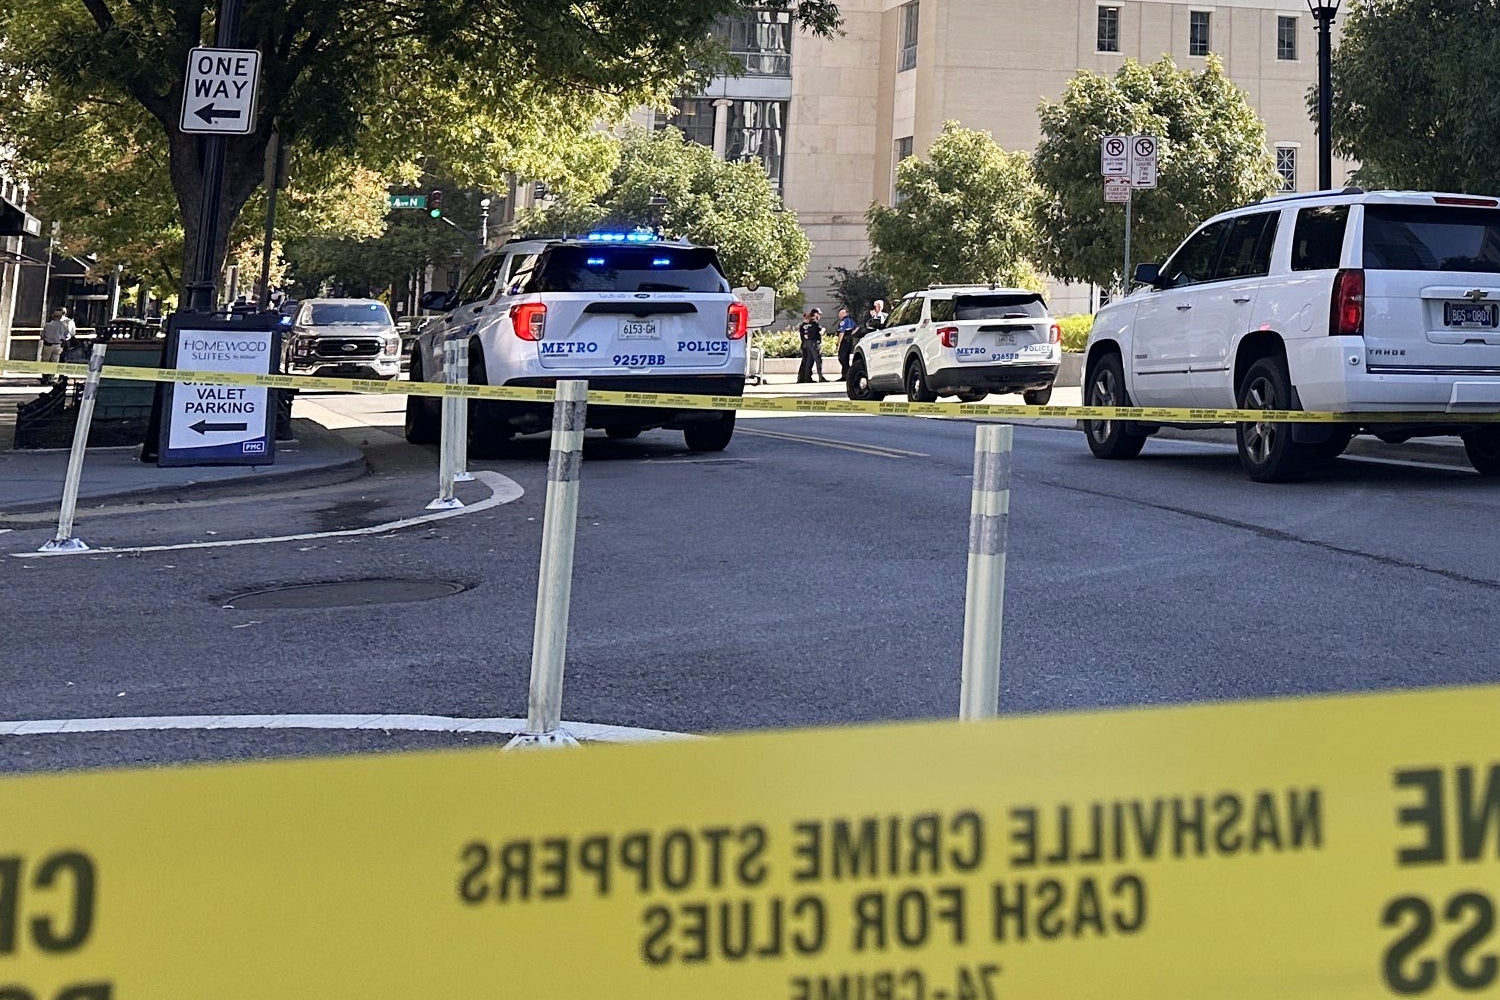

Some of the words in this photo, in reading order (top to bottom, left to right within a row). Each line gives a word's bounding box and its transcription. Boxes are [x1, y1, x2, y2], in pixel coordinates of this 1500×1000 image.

[198, 56, 248, 76] ONE
[195, 79, 248, 98] WAY
[410, 198, 418, 206] N
[184, 340, 266, 351] HOMEWOOD
[541, 342, 598, 353] METRO
[677, 341, 728, 352] POLICE
[192, 352, 230, 360] SUITES
[612, 354, 666, 366] 9257BB
[197, 389, 246, 400] VALET
[185, 403, 254, 413] PARKING
